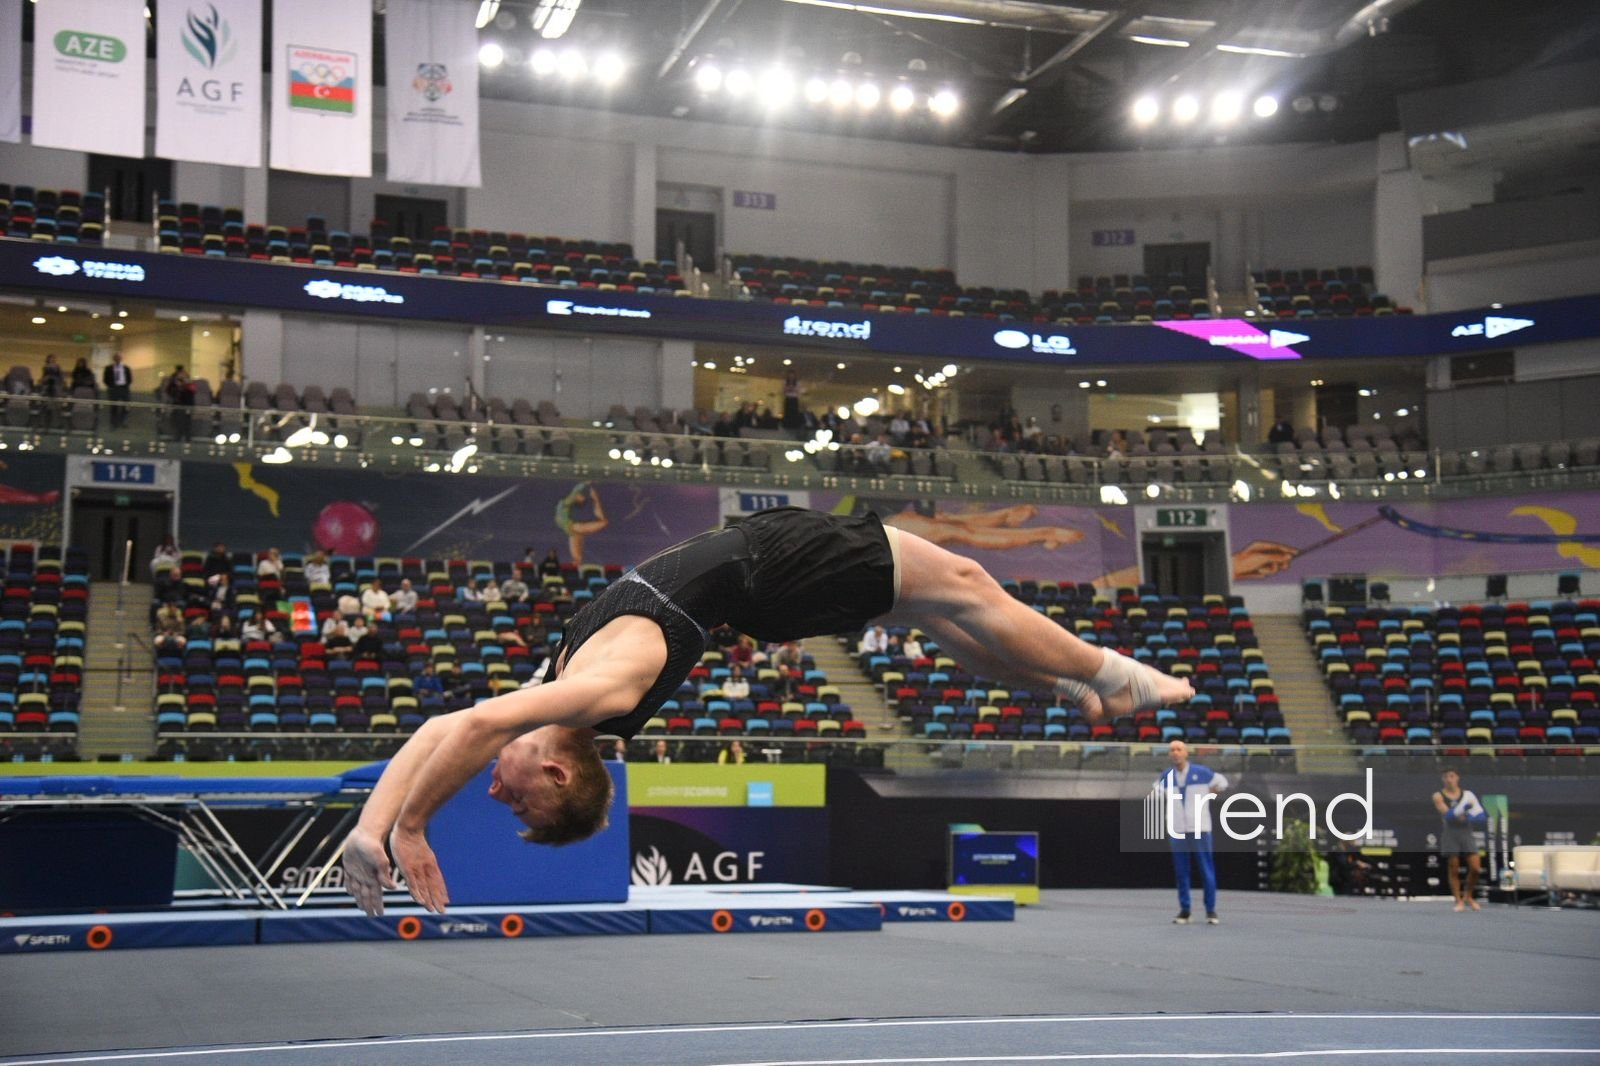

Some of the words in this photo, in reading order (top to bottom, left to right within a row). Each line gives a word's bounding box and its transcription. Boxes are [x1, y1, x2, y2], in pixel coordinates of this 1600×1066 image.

[64, 34, 114, 59] AZE
[176, 76, 244, 102] AGF
[1032, 333, 1070, 350] LG
[107, 464, 141, 481] 114
[1168, 509, 1197, 526] 112
[683, 851, 765, 882] AGF
[29, 934, 71, 945] SPIETH
